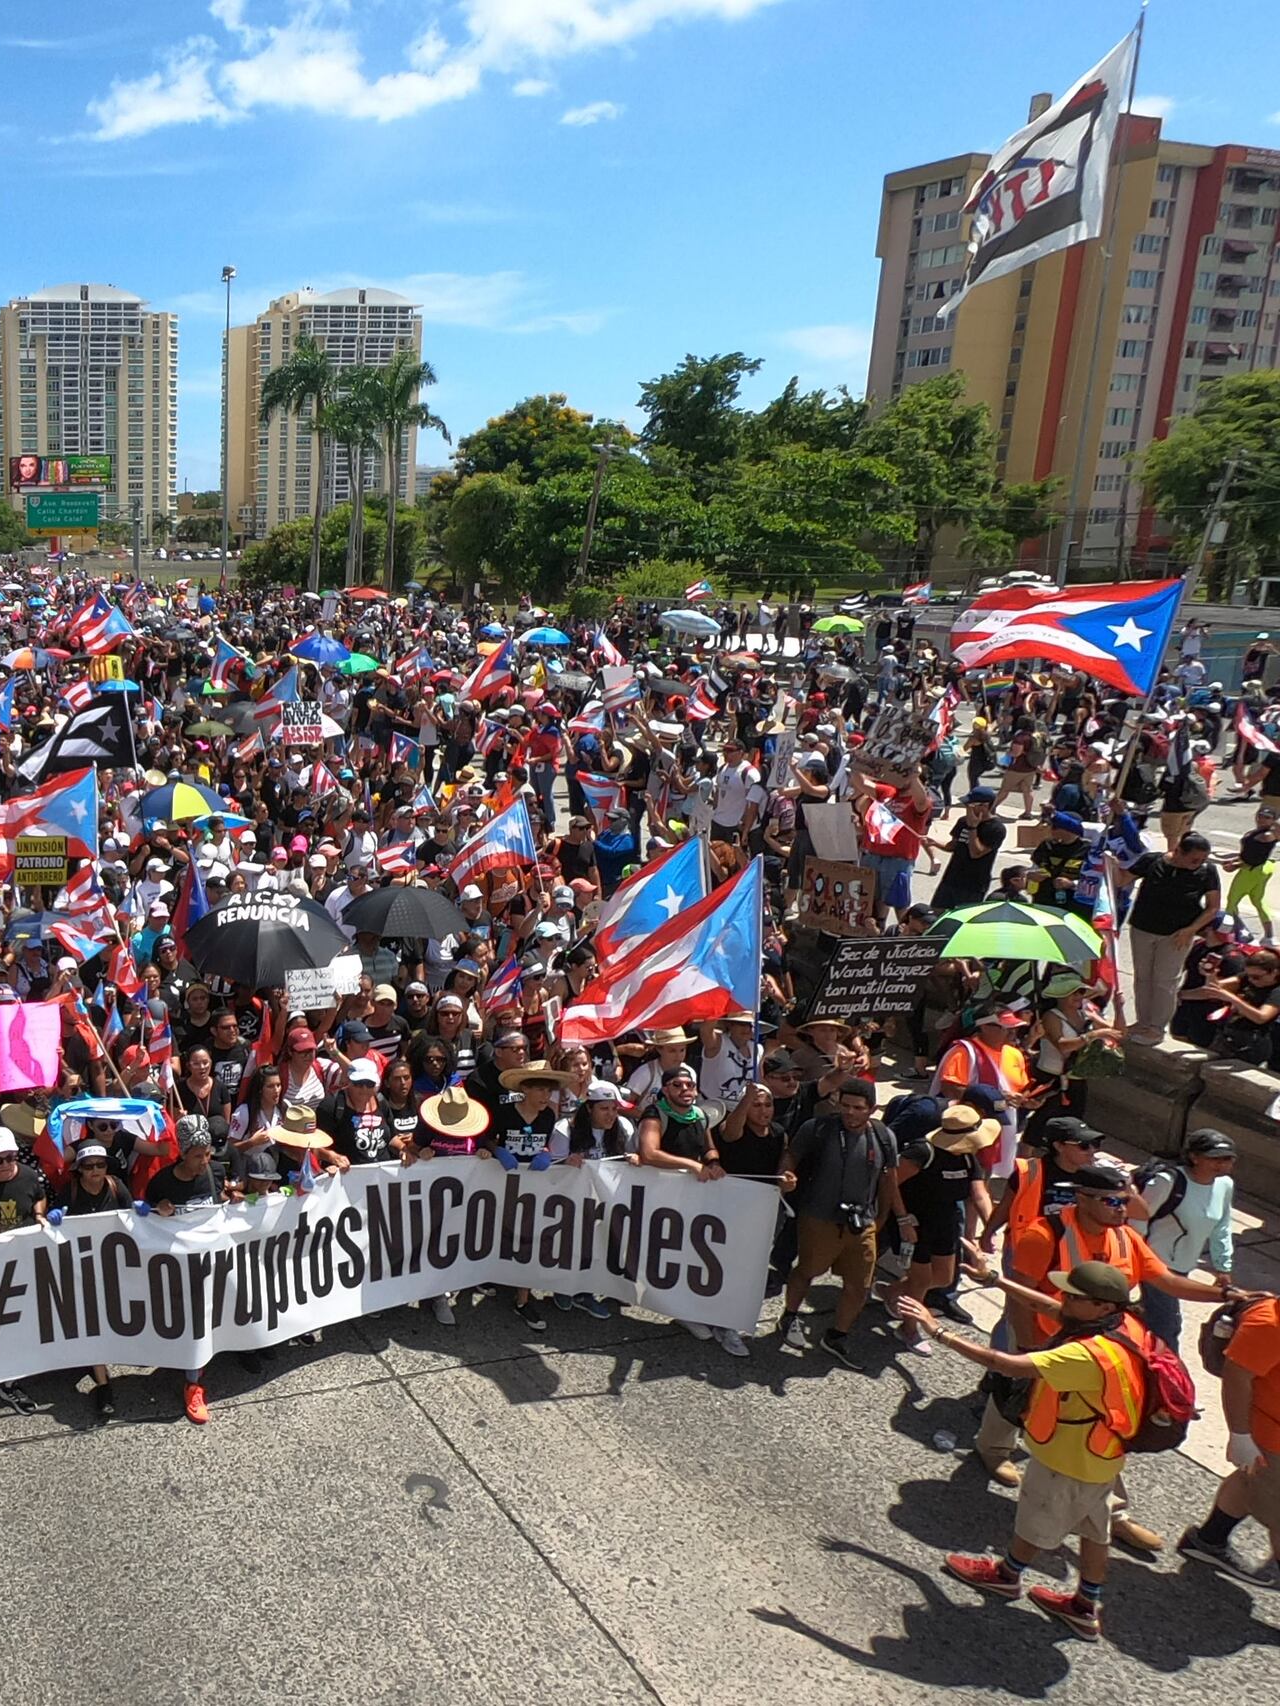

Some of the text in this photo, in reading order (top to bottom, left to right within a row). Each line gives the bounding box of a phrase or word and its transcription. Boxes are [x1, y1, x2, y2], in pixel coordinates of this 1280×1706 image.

[16, 856, 64, 868] PATRONO
[227, 892, 301, 908] RICKY
[217, 904, 310, 932] RENUNCIA
[837, 944, 939, 962] Sec de Justicia
[830, 962, 934, 982] Wanda Vázquez
[885, 982, 917, 994] como
[814, 1001, 826, 1015] la
[827, 1001, 871, 1018] crayola
